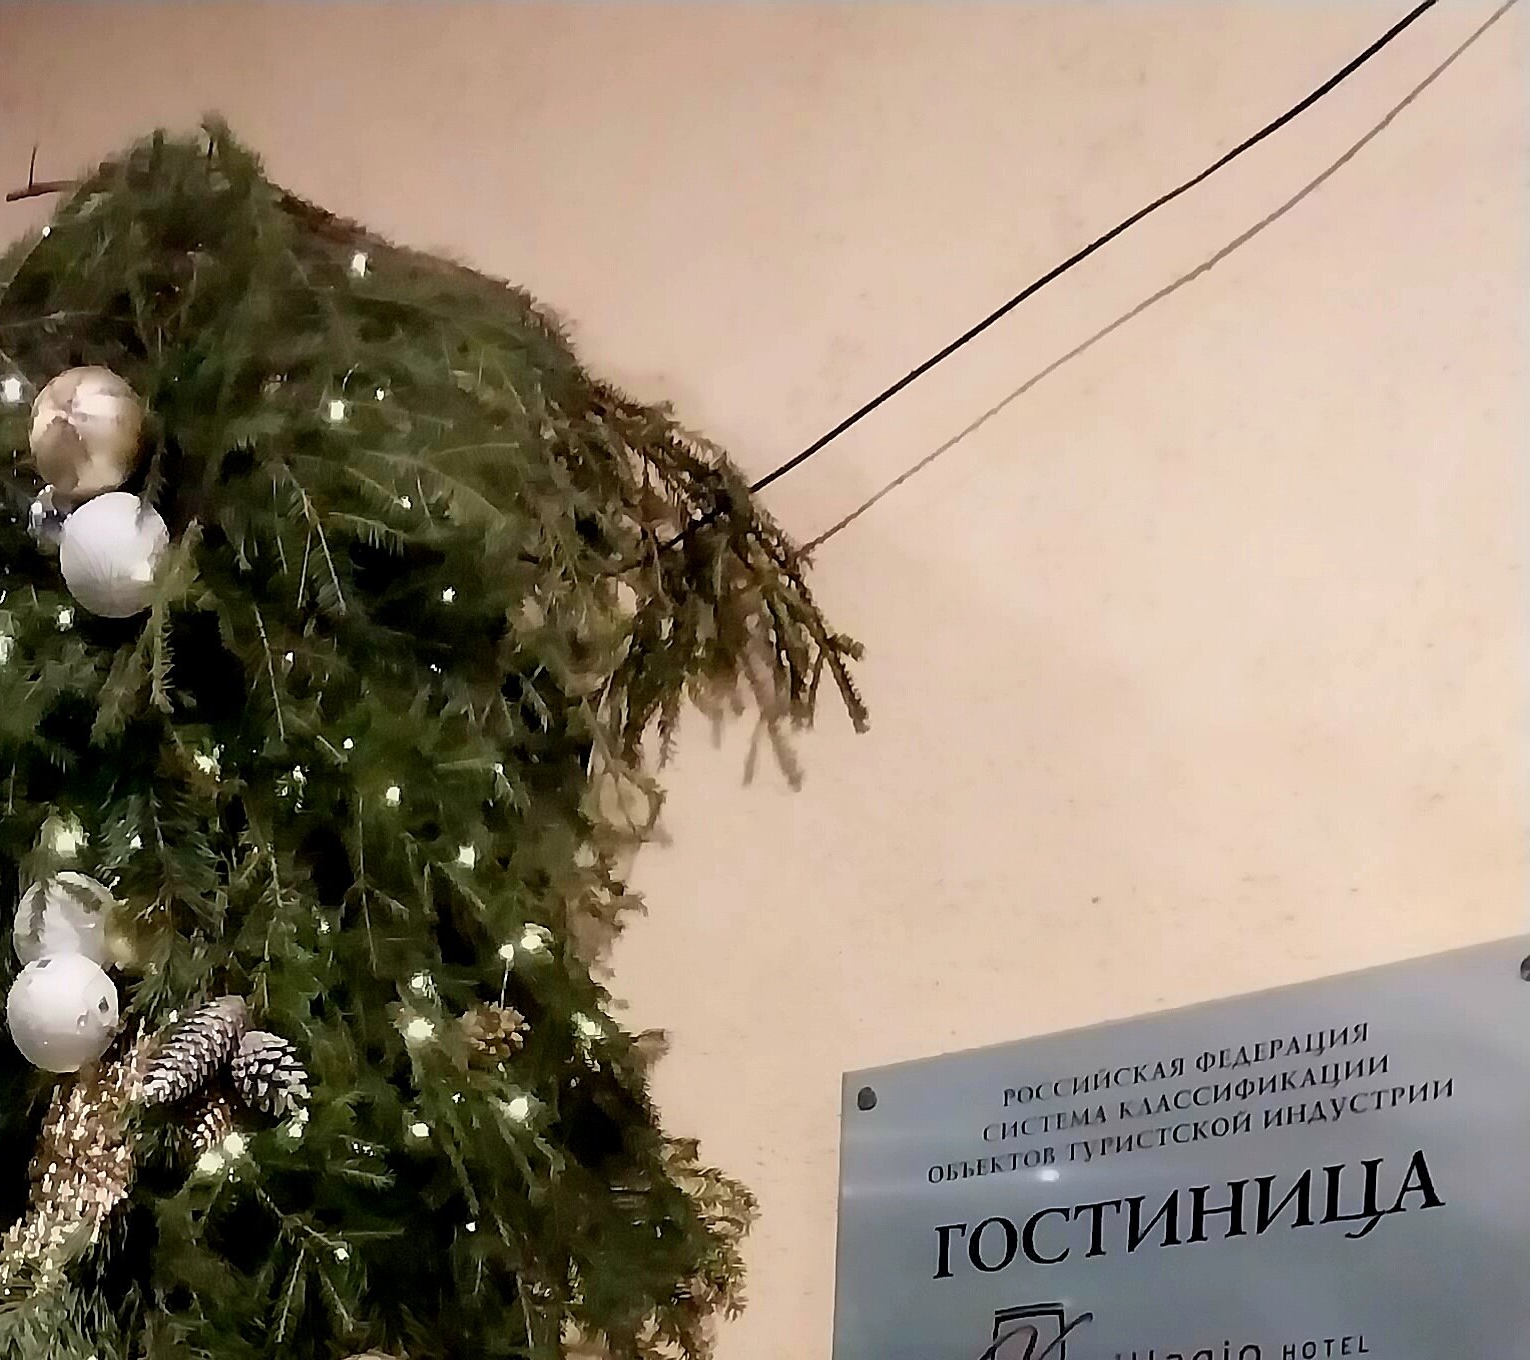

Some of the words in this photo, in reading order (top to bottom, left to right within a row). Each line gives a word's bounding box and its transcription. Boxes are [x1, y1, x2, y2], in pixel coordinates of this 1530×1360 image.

[982, 1103, 1108, 1144] СИСТЕМА
[1119, 1054, 1390, 1120] КЛАССИФИКАЦИИ
[1002, 1057, 1186, 1108] РОССИЙСКАЯ
[1195, 1022, 1370, 1075] ФЕДЕРАЦИЯ
[927, 1146, 1056, 1184] ОБЪЕКТОВ
[1069, 1110, 1252, 1163] ТУРИСТСКОЙ
[1263, 1078, 1455, 1130] ИНДУСТРИИ
[933, 1149, 1446, 1280] ГОСТИНИЦА
